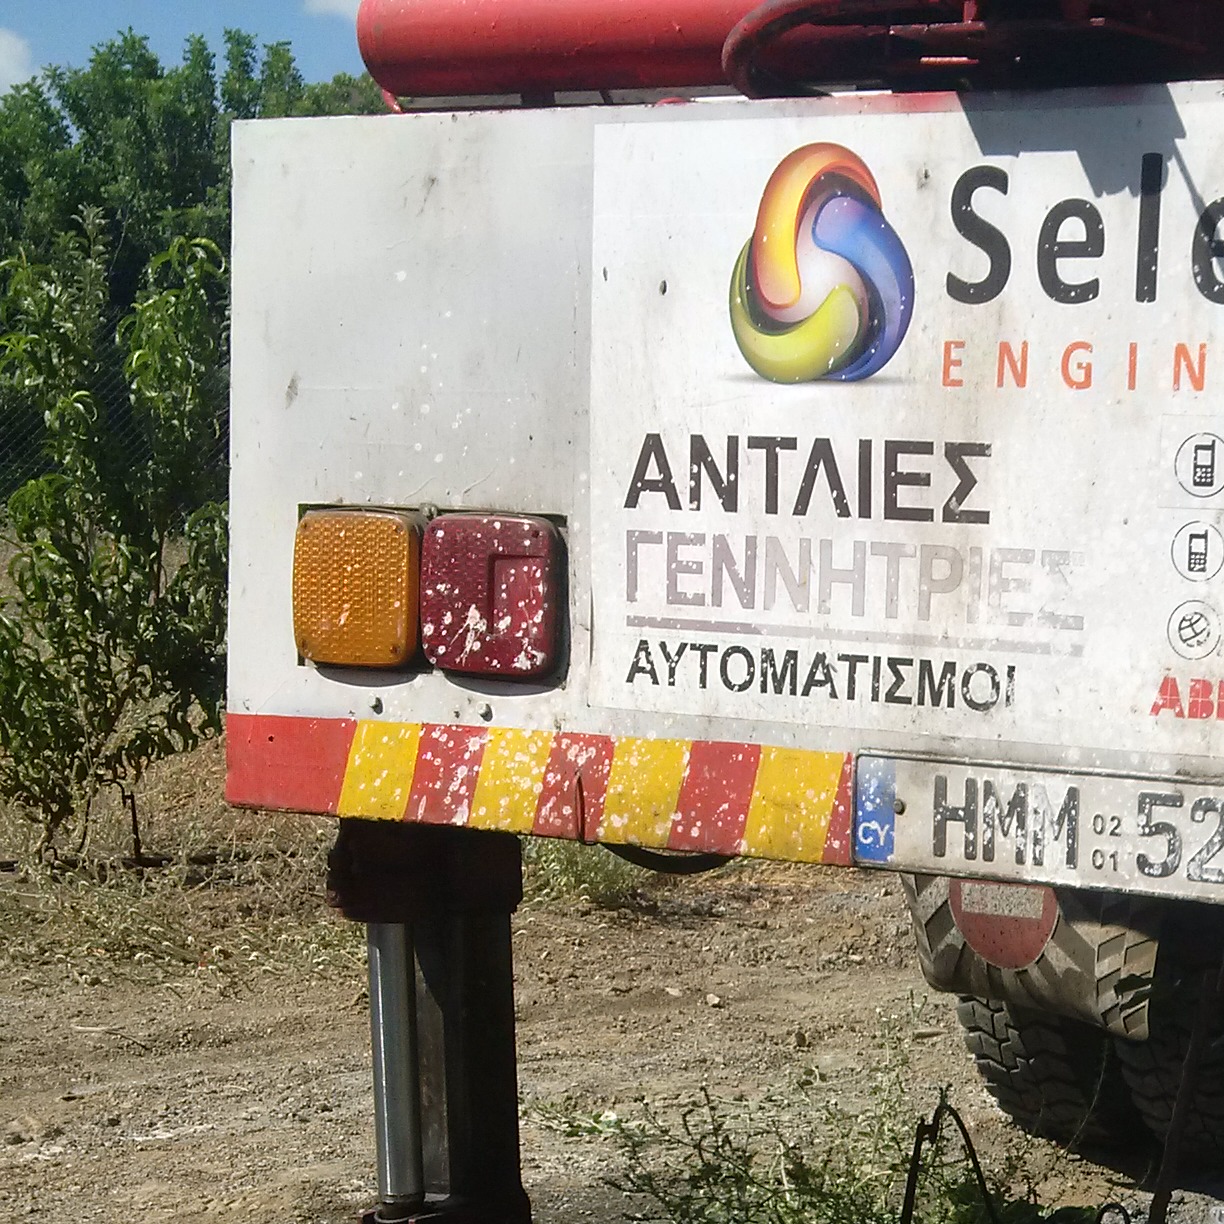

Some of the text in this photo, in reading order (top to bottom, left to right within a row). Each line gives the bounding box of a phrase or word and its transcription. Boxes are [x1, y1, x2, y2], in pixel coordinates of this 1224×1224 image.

[623, 432, 992, 525] ΑΝΤΛΙΕΣ
[625, 639, 1017, 712] ΑΥΤΟΜΑΤΙΣΜΟΙ
[858, 822, 891, 847] CY
[932, 775, 1080, 870] HMM
[1092, 813, 1121, 836] 02
[1092, 848, 1118, 871] 01
